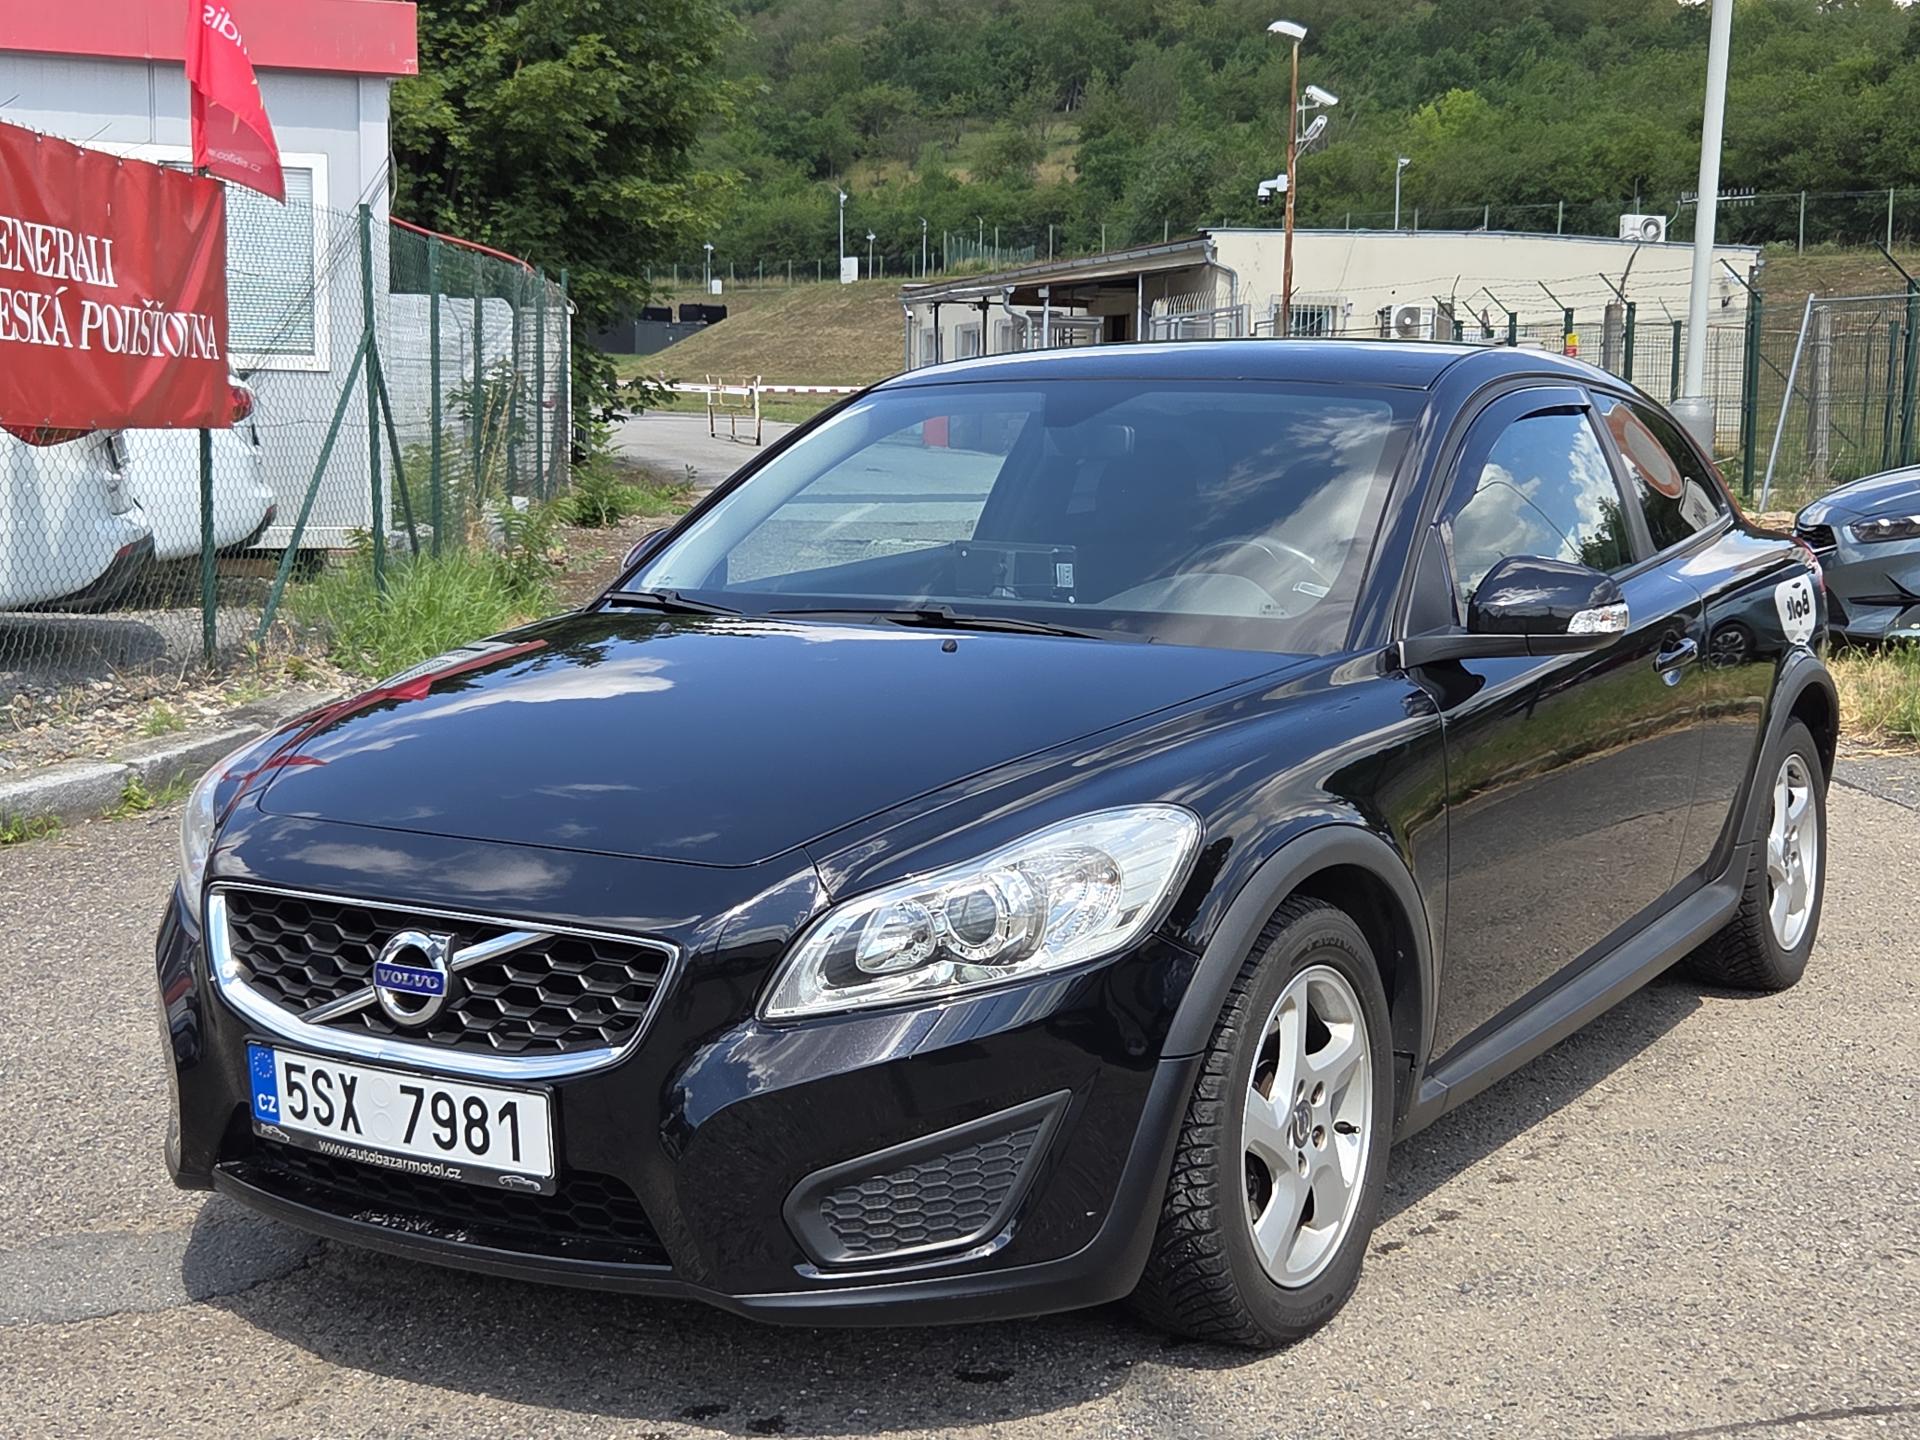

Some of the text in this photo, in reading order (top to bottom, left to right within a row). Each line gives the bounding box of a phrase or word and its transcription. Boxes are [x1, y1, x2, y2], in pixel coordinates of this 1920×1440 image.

[0, 215, 118, 288] ENERALI
[0, 286, 73, 348] ESKÁ
[378, 968, 440, 989] VOLVO
[257, 1093, 277, 1113] CZ
[284, 1061, 521, 1163] 5SX 7981
[318, 1140, 462, 1180] www.autobazarmotol.cz
